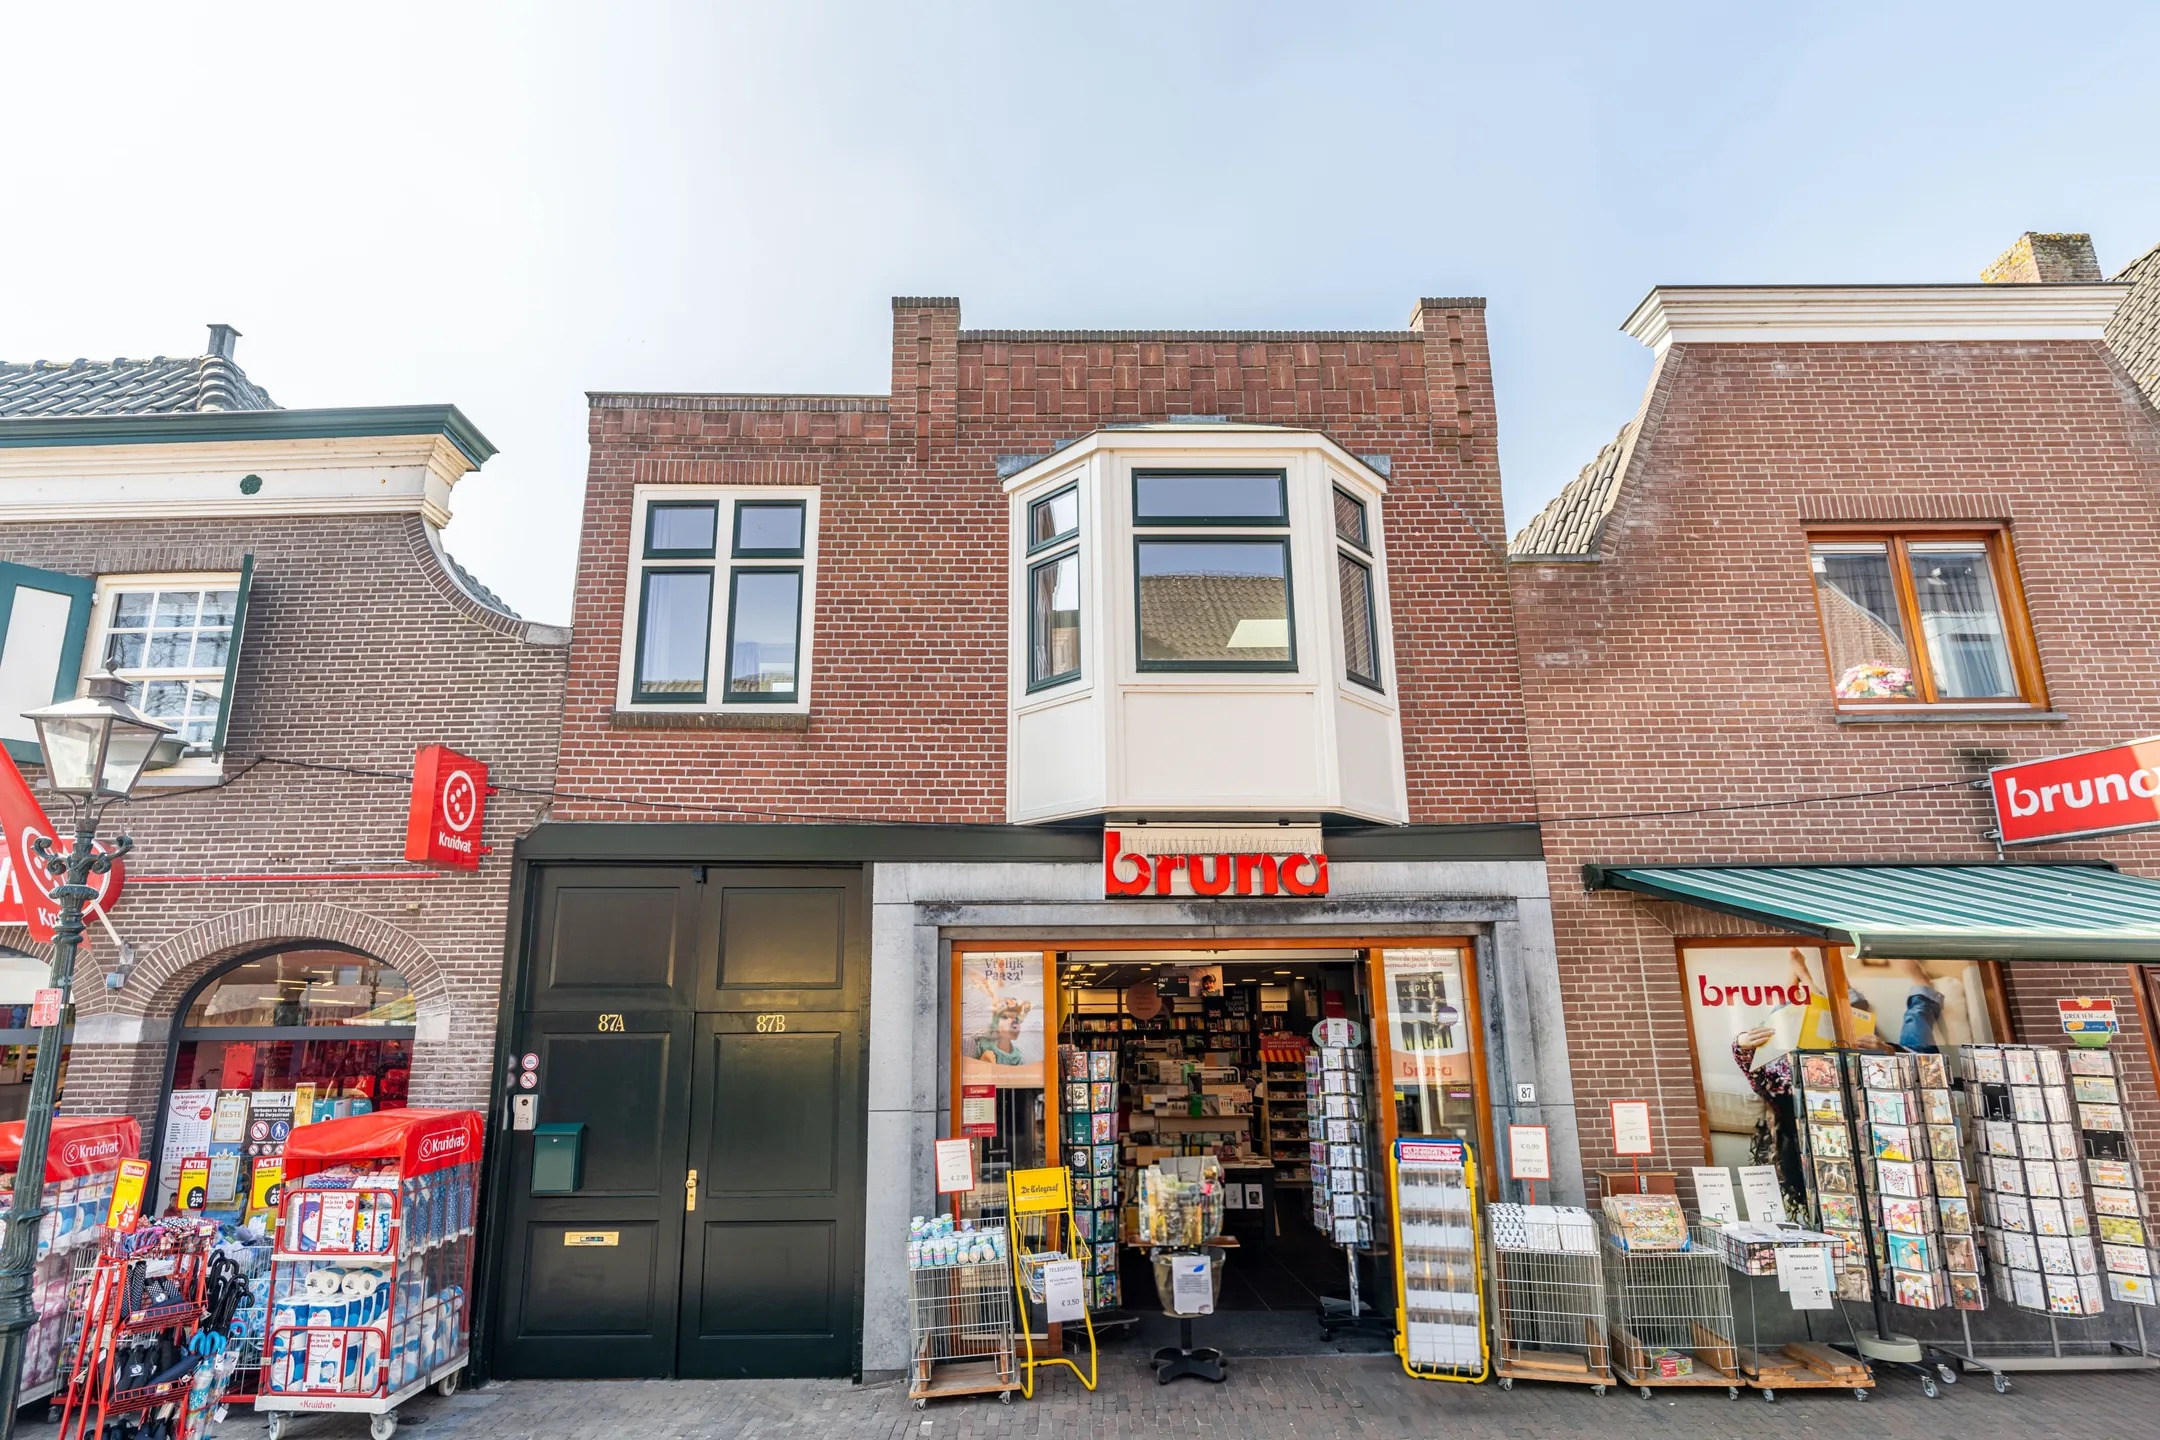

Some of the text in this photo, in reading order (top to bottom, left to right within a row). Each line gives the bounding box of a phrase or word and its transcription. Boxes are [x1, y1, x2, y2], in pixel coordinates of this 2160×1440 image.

[2005, 767, 2160, 818] bruna
[438, 831, 472, 853] Kruidvat
[1105, 831, 1329, 897] bruna
[985, 957, 1025, 970] Vrolijk
[1698, 975, 1812, 1007] bruna
[598, 1014, 786, 1033] 87A 87B
[1521, 1087, 1532, 1099] 87
[79, 1140, 120, 1158] Kruidvat
[431, 1133, 466, 1153] Kruidvat
[184, 1160, 208, 1169] ACTIE!
[1020, 1183, 1059, 1194] De Telegraaf
[1049, 1264, 1077, 1273] TELEGRAAF
[1067, 1298, 1080, 1306] 3.50
[303, 1400, 333, 1409] Kruidvat
